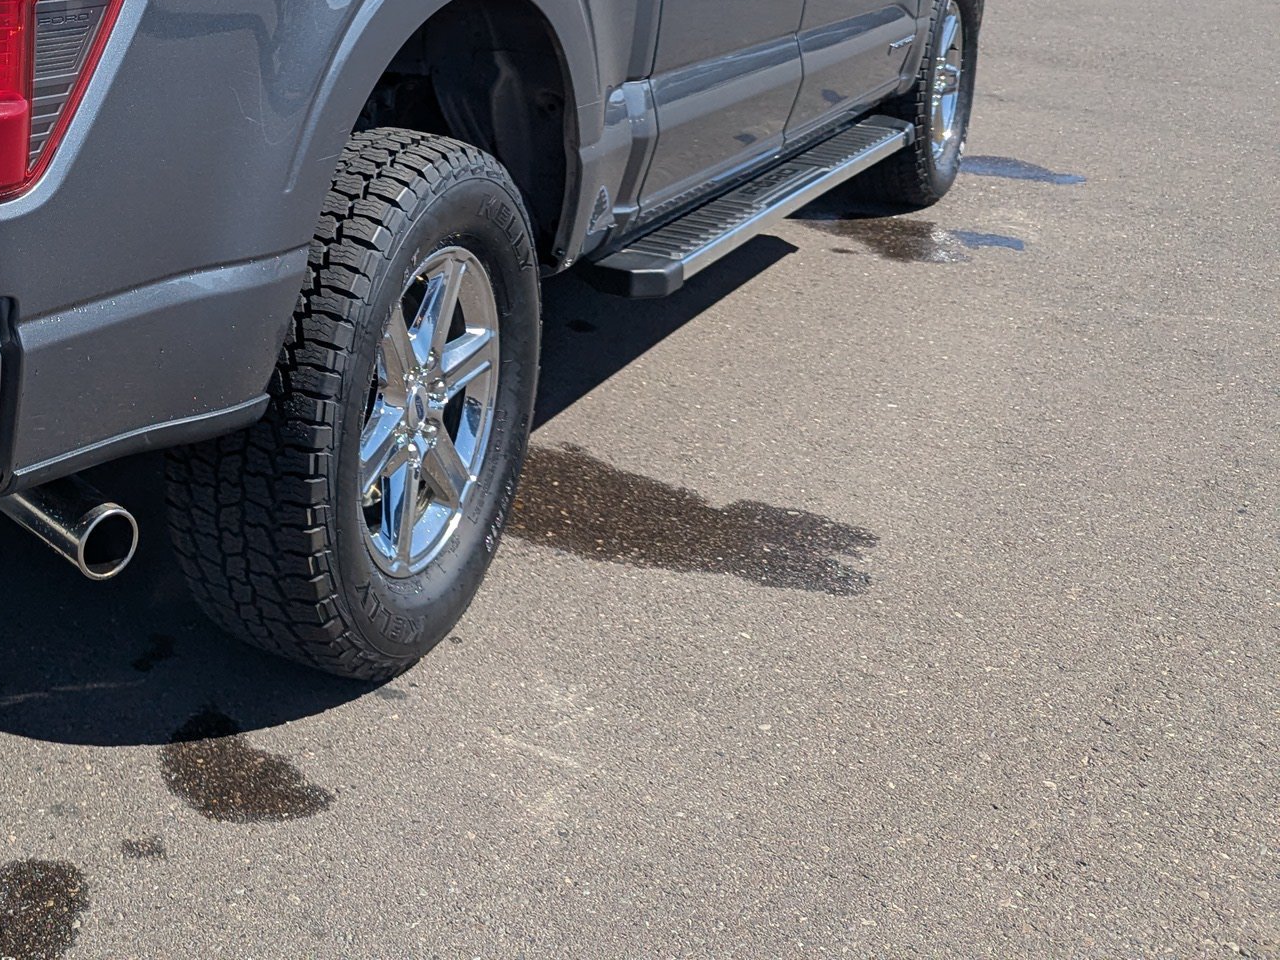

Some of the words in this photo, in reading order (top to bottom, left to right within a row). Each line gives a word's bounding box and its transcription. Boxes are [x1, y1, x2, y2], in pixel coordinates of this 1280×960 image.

[37, 12, 90, 27] FORD
[476, 193, 534, 272] KELLY
[354, 581, 426, 644] KELLY
